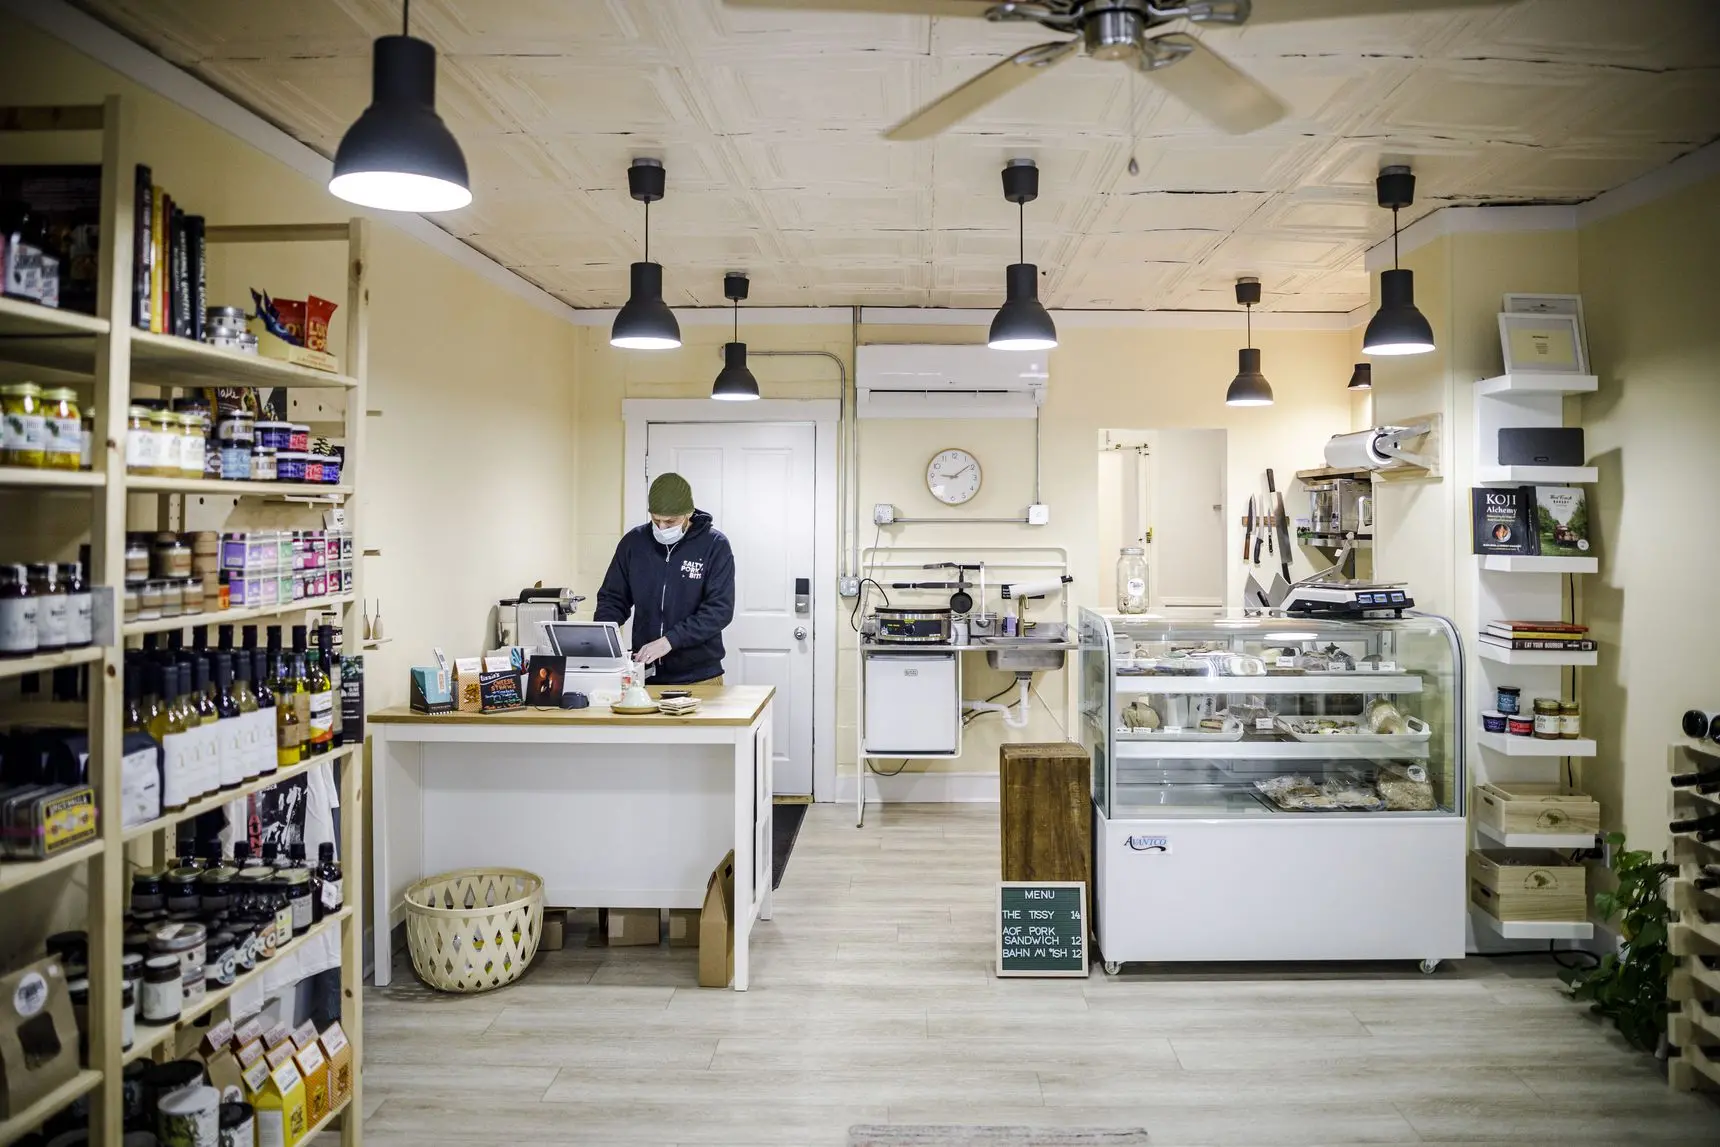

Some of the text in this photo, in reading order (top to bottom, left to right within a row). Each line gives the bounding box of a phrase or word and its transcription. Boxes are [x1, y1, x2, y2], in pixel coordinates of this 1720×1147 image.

[1486, 494, 1516, 506] KOJI
[1486, 506, 1517, 515] Alchemy
[683, 560, 703, 569] SALTY
[1025, 890, 1055, 899] MENU
[1002, 910, 1081, 919] THE TISSY 14
[1002, 926, 1055, 935] AOF PORK
[1005, 936, 1082, 945] SANDWICH 12
[1002, 948, 1030, 958] BAHN
[1072, 950, 1082, 958] 12
